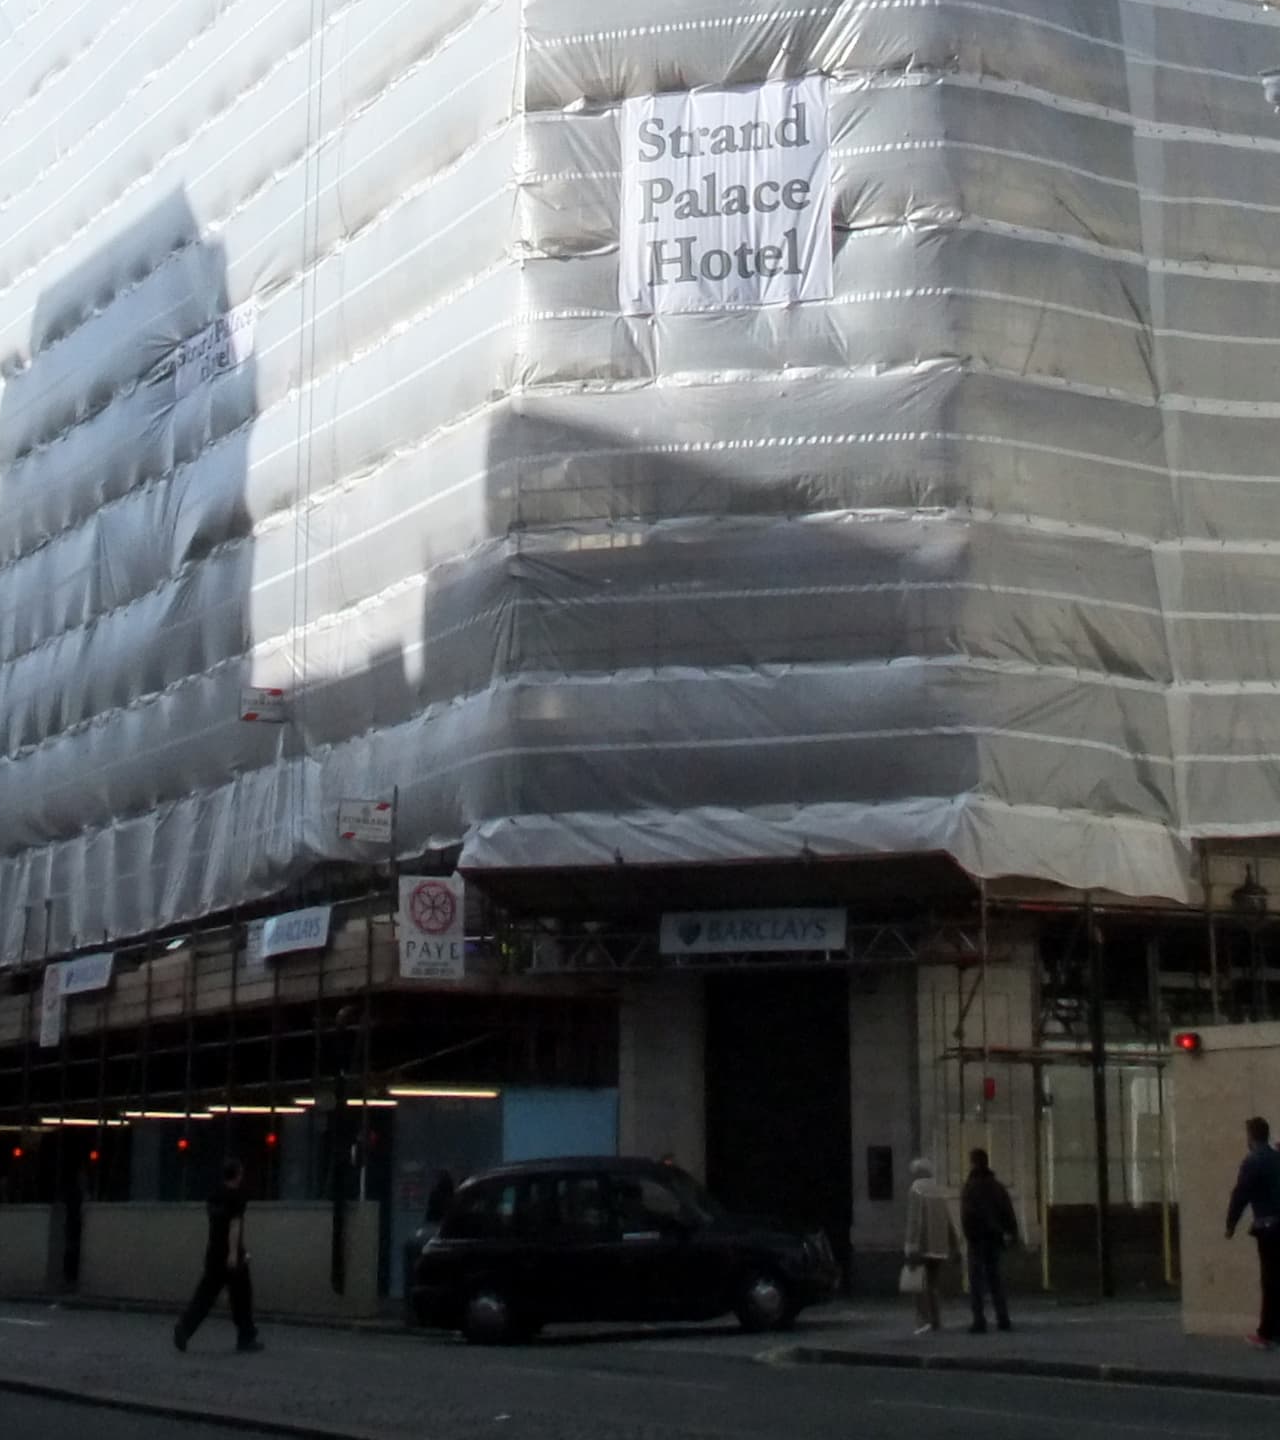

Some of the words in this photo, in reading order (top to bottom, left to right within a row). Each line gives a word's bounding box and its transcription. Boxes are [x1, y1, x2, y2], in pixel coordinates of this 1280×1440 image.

[638, 102, 810, 163] Strand
[639, 173, 811, 225] Palace
[647, 227, 803, 287] Hotel
[406, 940, 460, 960] PAYE
[707, 918, 826, 942] BARCLAYS
